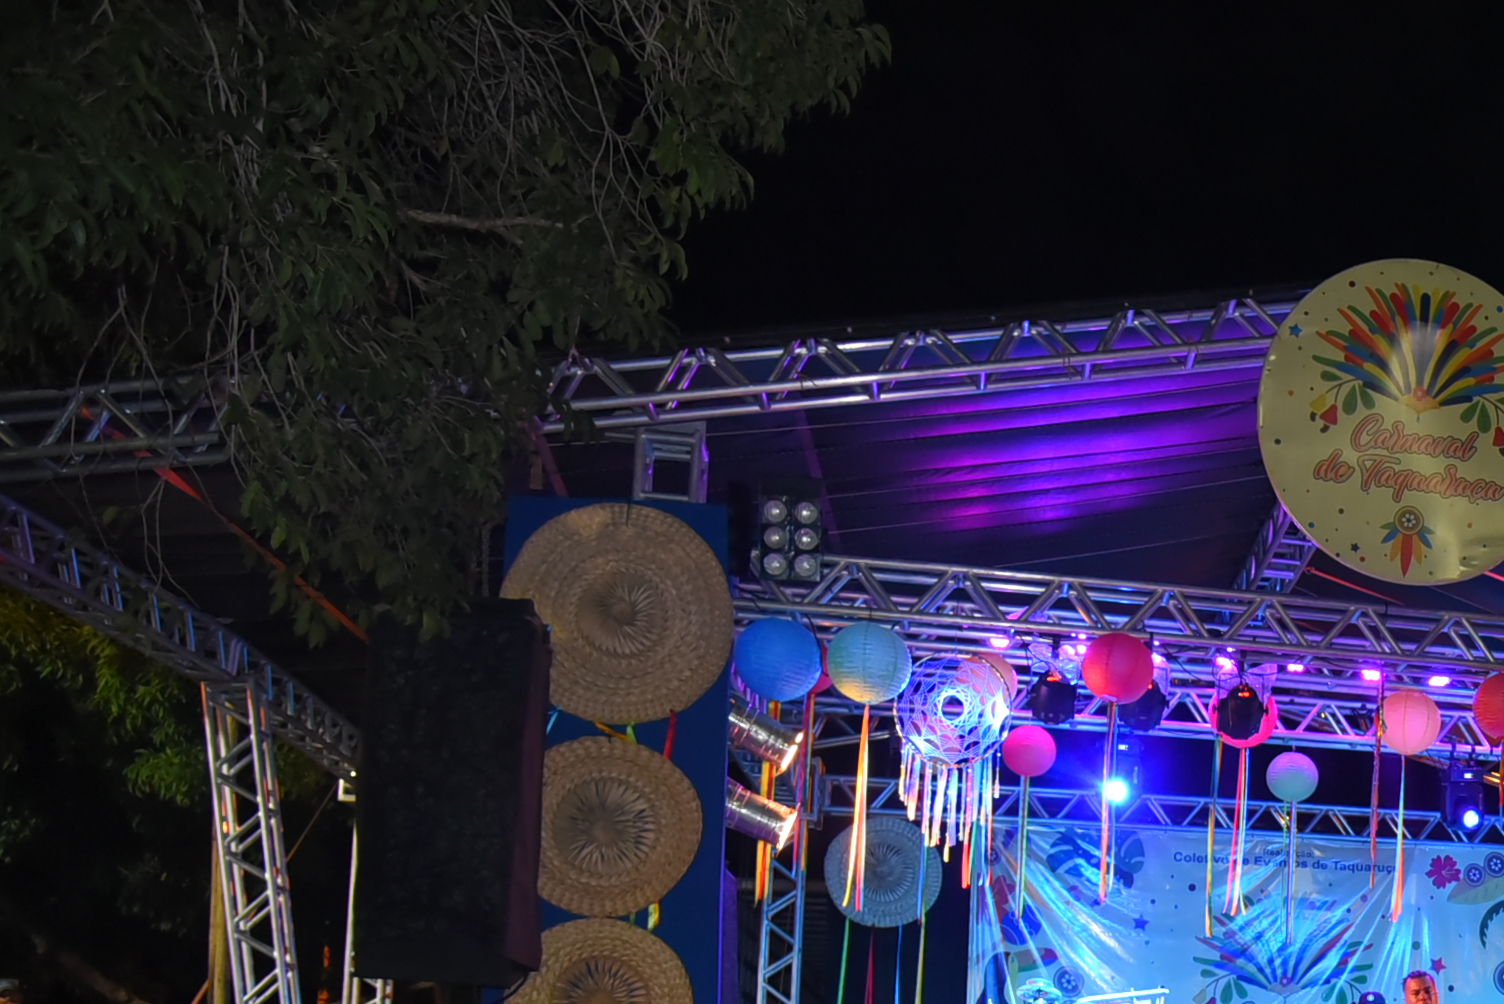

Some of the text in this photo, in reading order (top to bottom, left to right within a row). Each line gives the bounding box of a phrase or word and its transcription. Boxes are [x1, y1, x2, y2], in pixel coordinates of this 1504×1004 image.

[1351, 413, 1479, 461] Carnaval
[1314, 449, 1355, 482] de
[1312, 859, 1328, 870] de
[1333, 860, 1398, 875] Taquaruç
